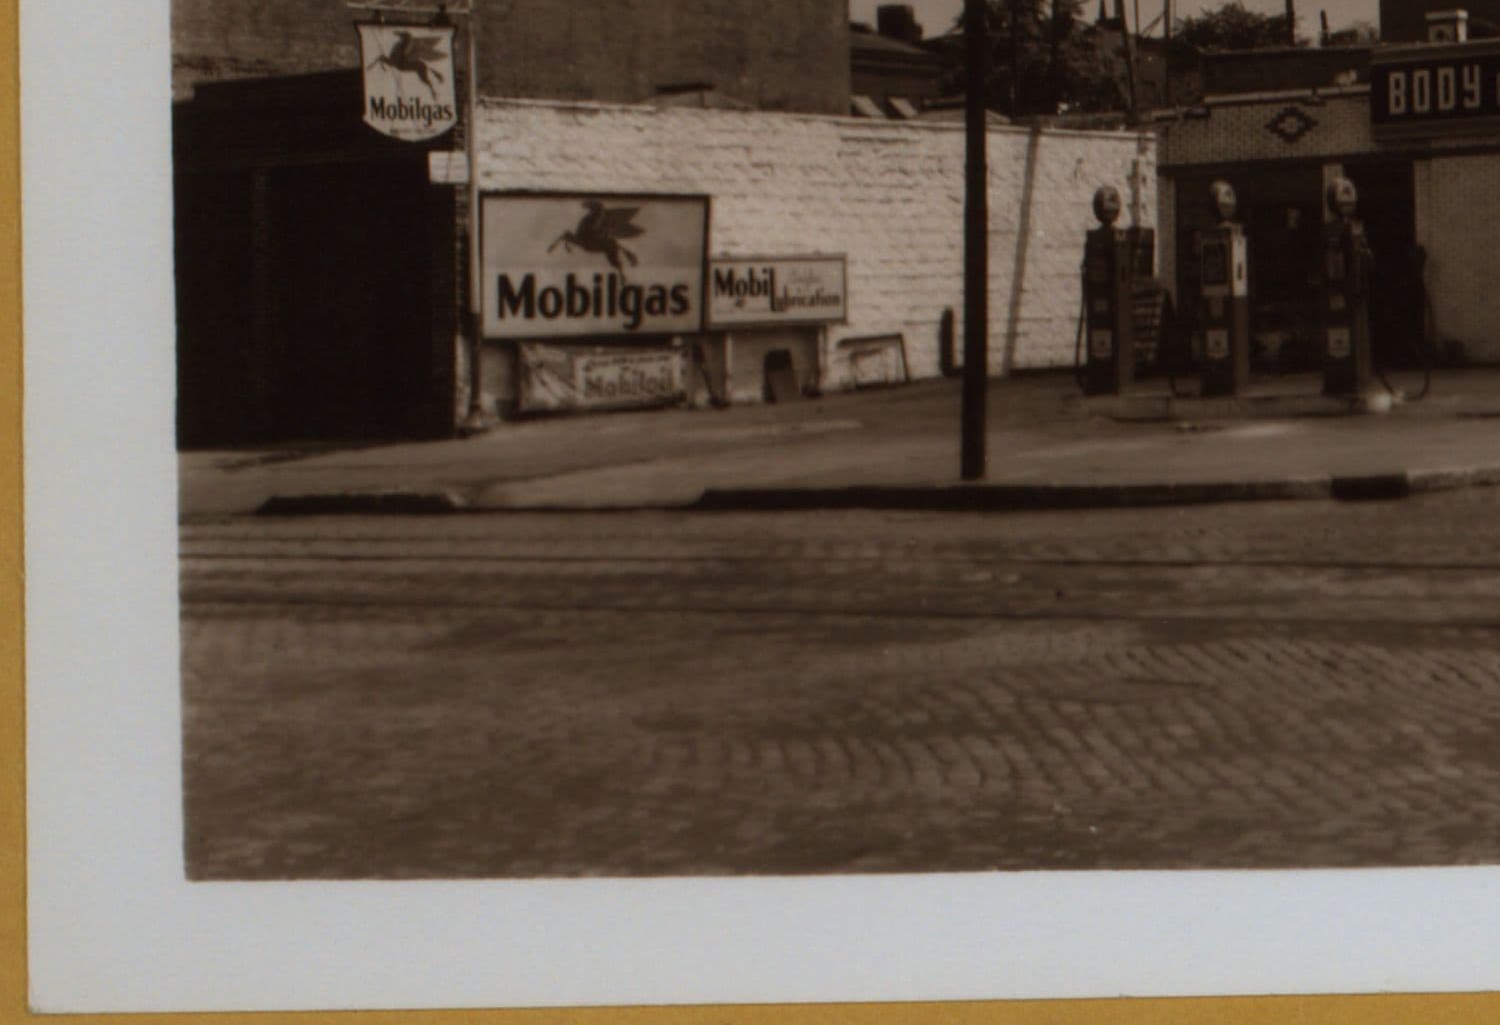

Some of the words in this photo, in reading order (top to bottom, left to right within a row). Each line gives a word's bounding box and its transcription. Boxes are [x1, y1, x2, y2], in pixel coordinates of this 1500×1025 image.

[369, 95, 453, 127] Mobilgas
[1388, 63, 1482, 116] BODY
[497, 272, 690, 330] Mobilgas
